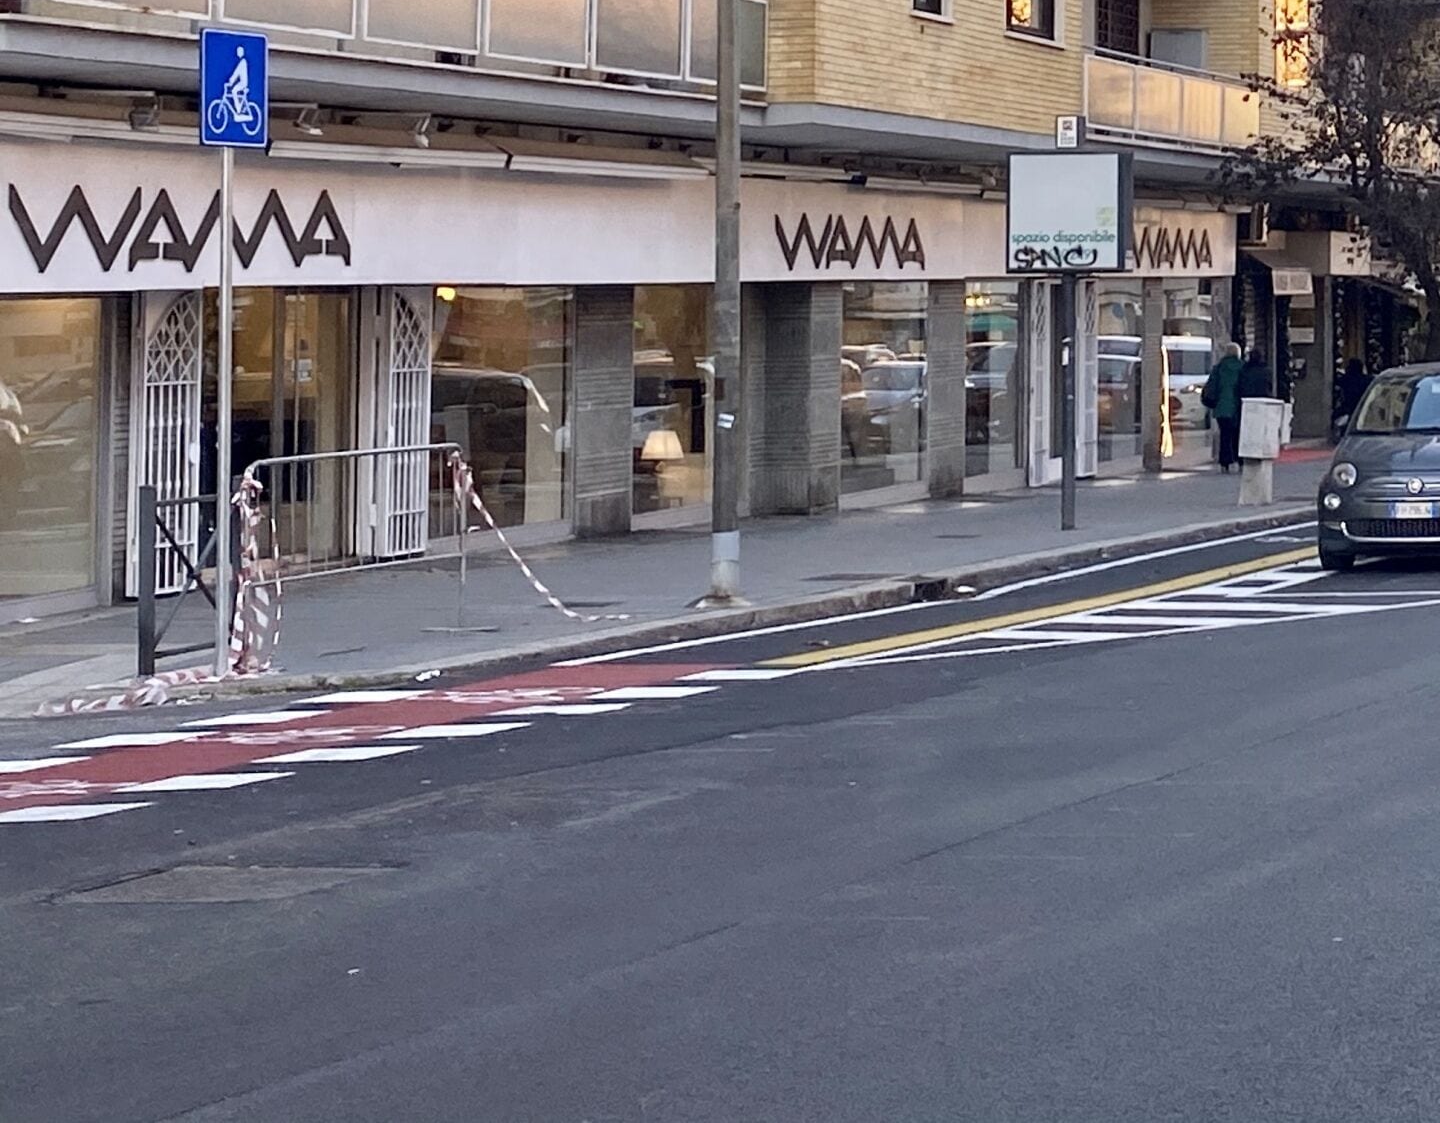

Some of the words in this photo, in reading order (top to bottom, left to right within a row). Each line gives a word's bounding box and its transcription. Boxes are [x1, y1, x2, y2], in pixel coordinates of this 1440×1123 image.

[8, 183, 351, 273] WAMA
[775, 212, 925, 271] WAMA
[1012, 232, 1050, 245] spazio
[1053, 229, 1115, 245] disponibile
